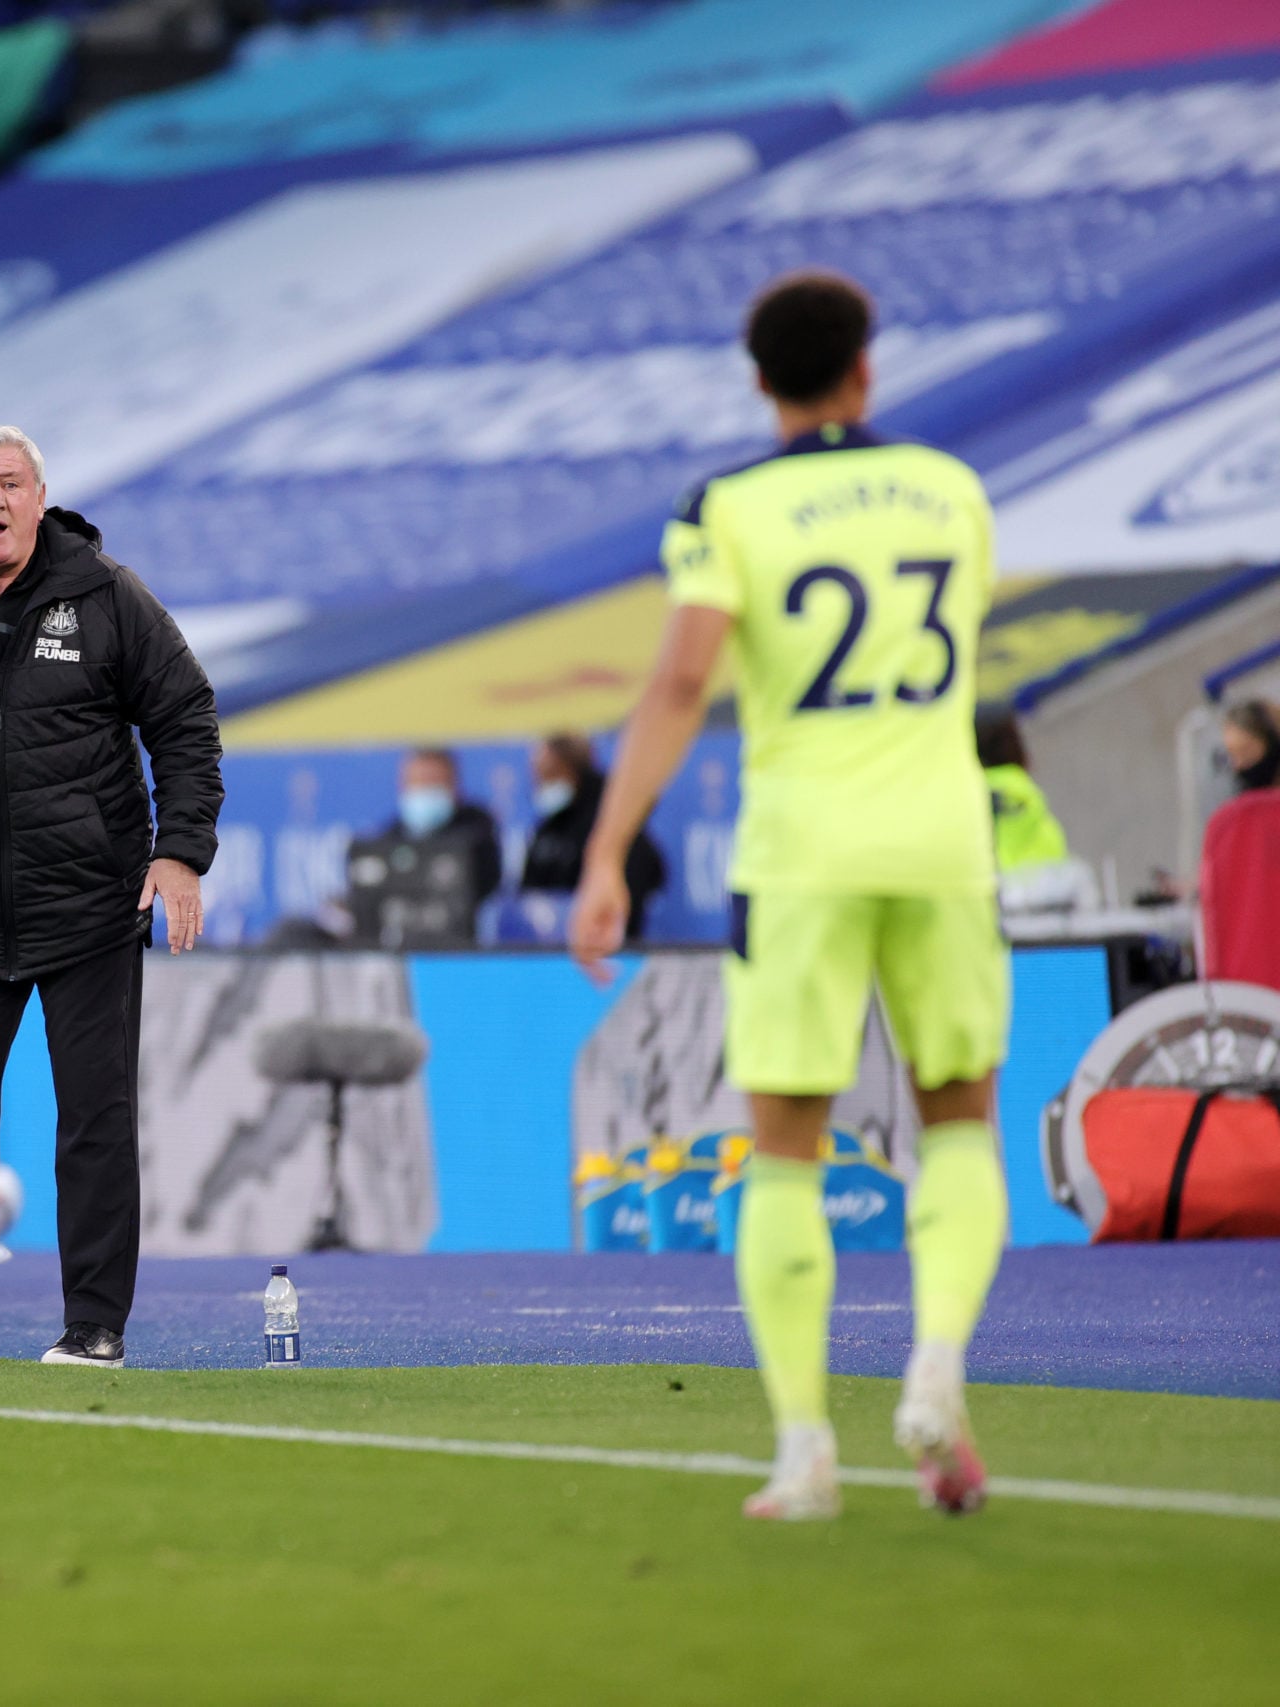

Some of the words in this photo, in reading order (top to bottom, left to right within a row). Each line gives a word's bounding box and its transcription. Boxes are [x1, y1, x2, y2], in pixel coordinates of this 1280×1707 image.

[34, 647, 81, 662] FUN88
[785, 559, 957, 709] 23
[1190, 1026, 1239, 1068] 12
